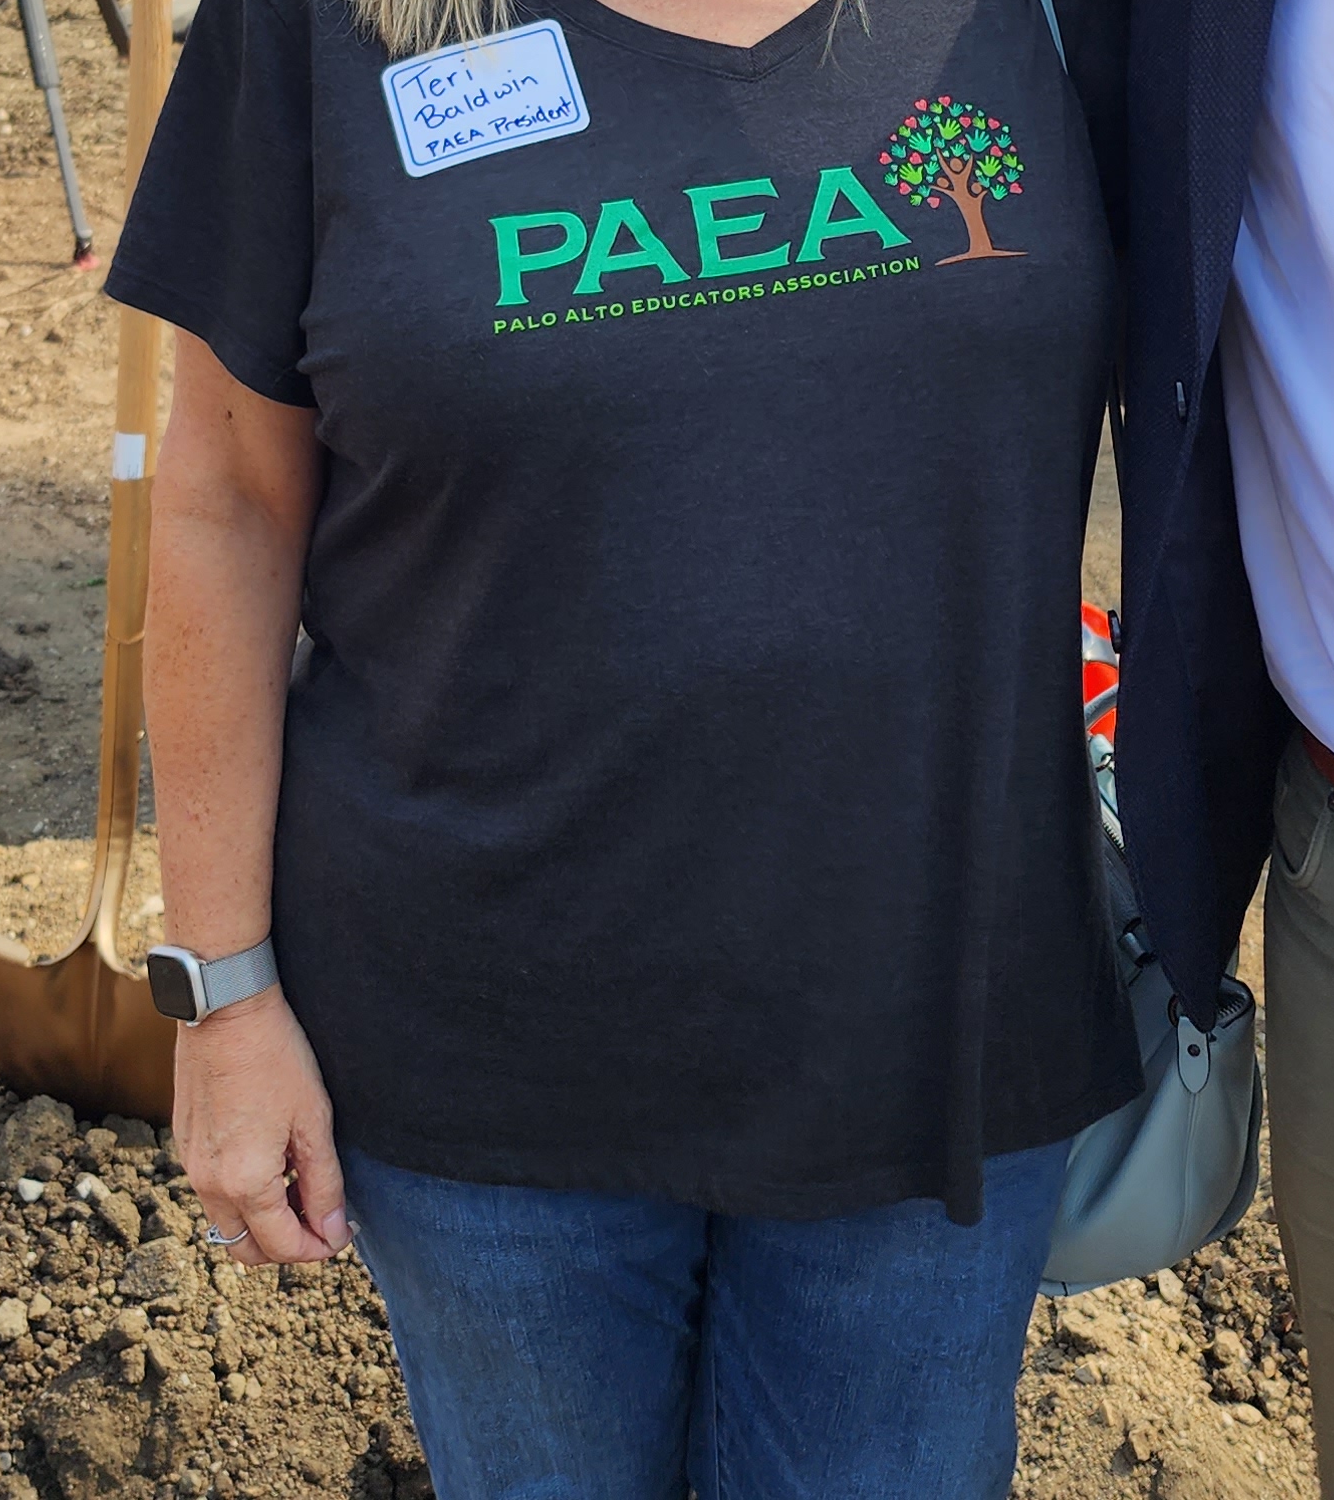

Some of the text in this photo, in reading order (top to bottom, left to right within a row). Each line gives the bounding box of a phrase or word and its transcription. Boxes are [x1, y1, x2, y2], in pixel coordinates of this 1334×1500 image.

[401, 58, 473, 99] Teri
[414, 69, 538, 129] Baldwin
[425, 96, 572, 157] PAEA President
[487, 165, 914, 307] PAEA
[493, 256, 921, 335] PALO ALTO EDUCATORS ASSOCIATION
